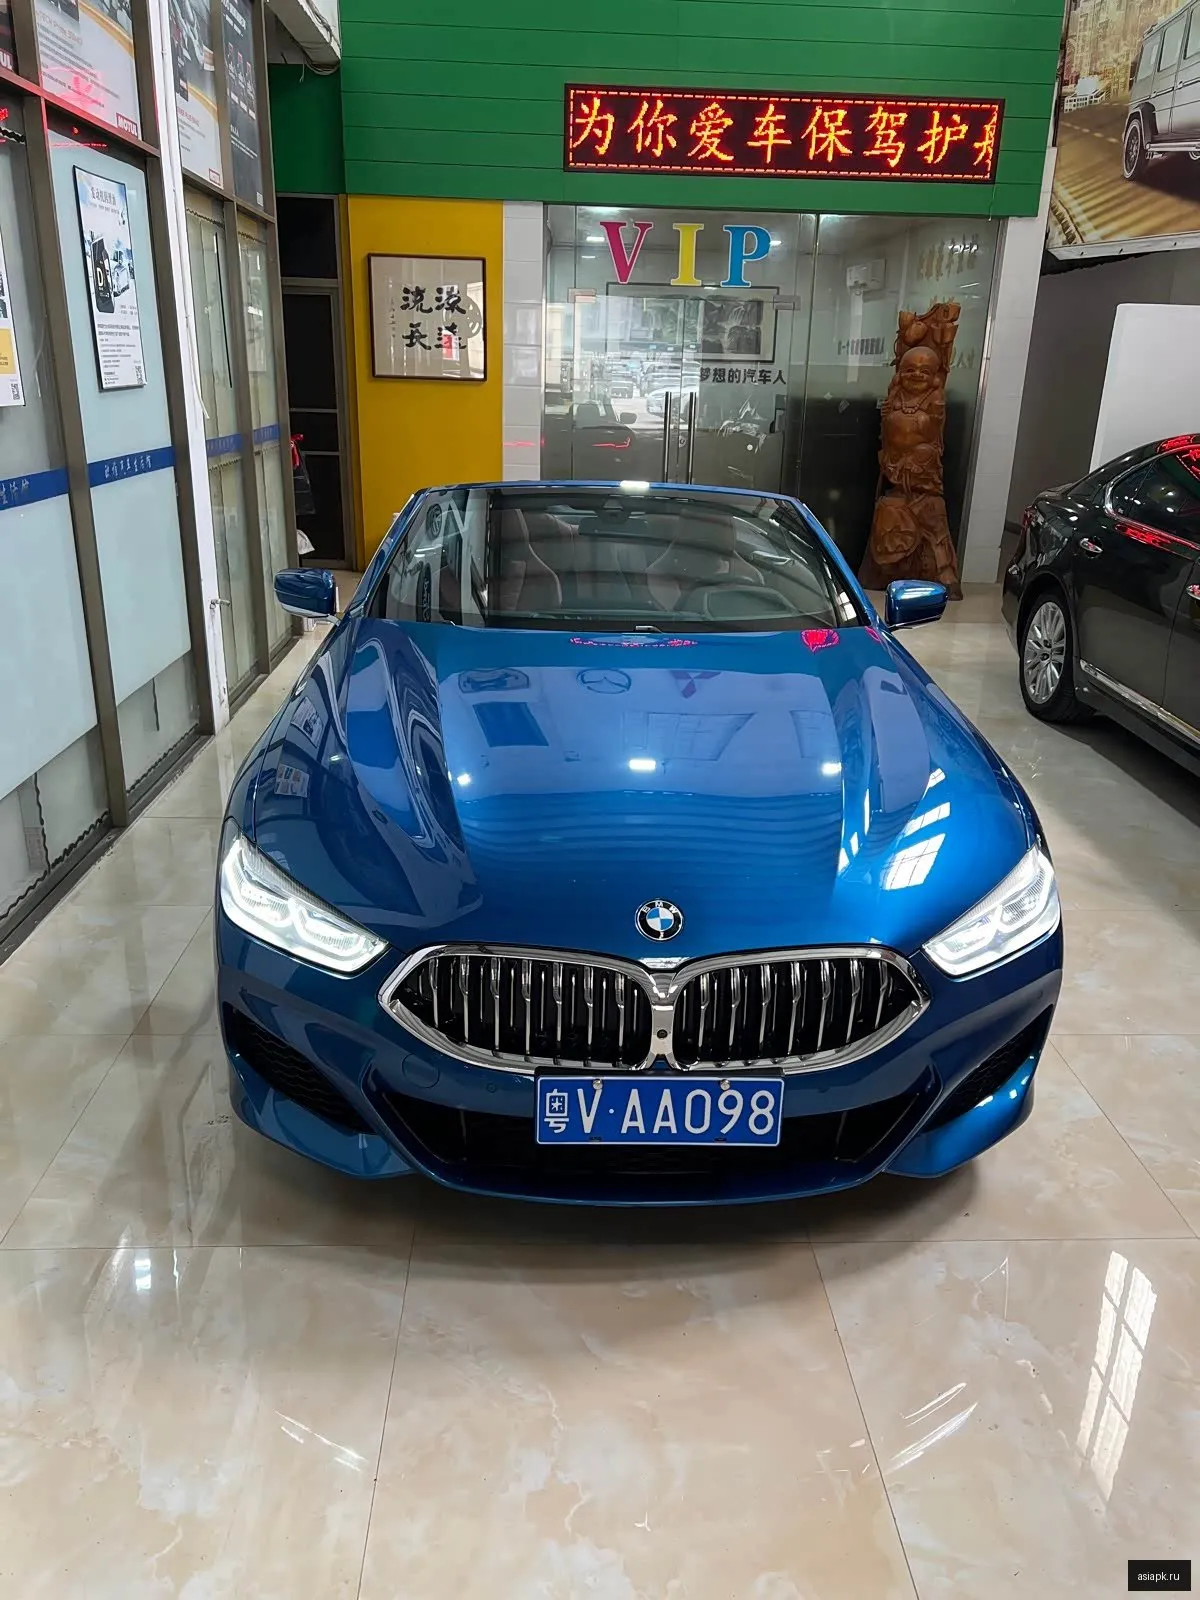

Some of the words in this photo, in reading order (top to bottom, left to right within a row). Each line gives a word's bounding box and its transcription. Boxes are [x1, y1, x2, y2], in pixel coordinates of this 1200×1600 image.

[118, 114, 138, 136] MOTUL
[600, 221, 772, 287] VIP
[641, 901, 679, 914] BMW
